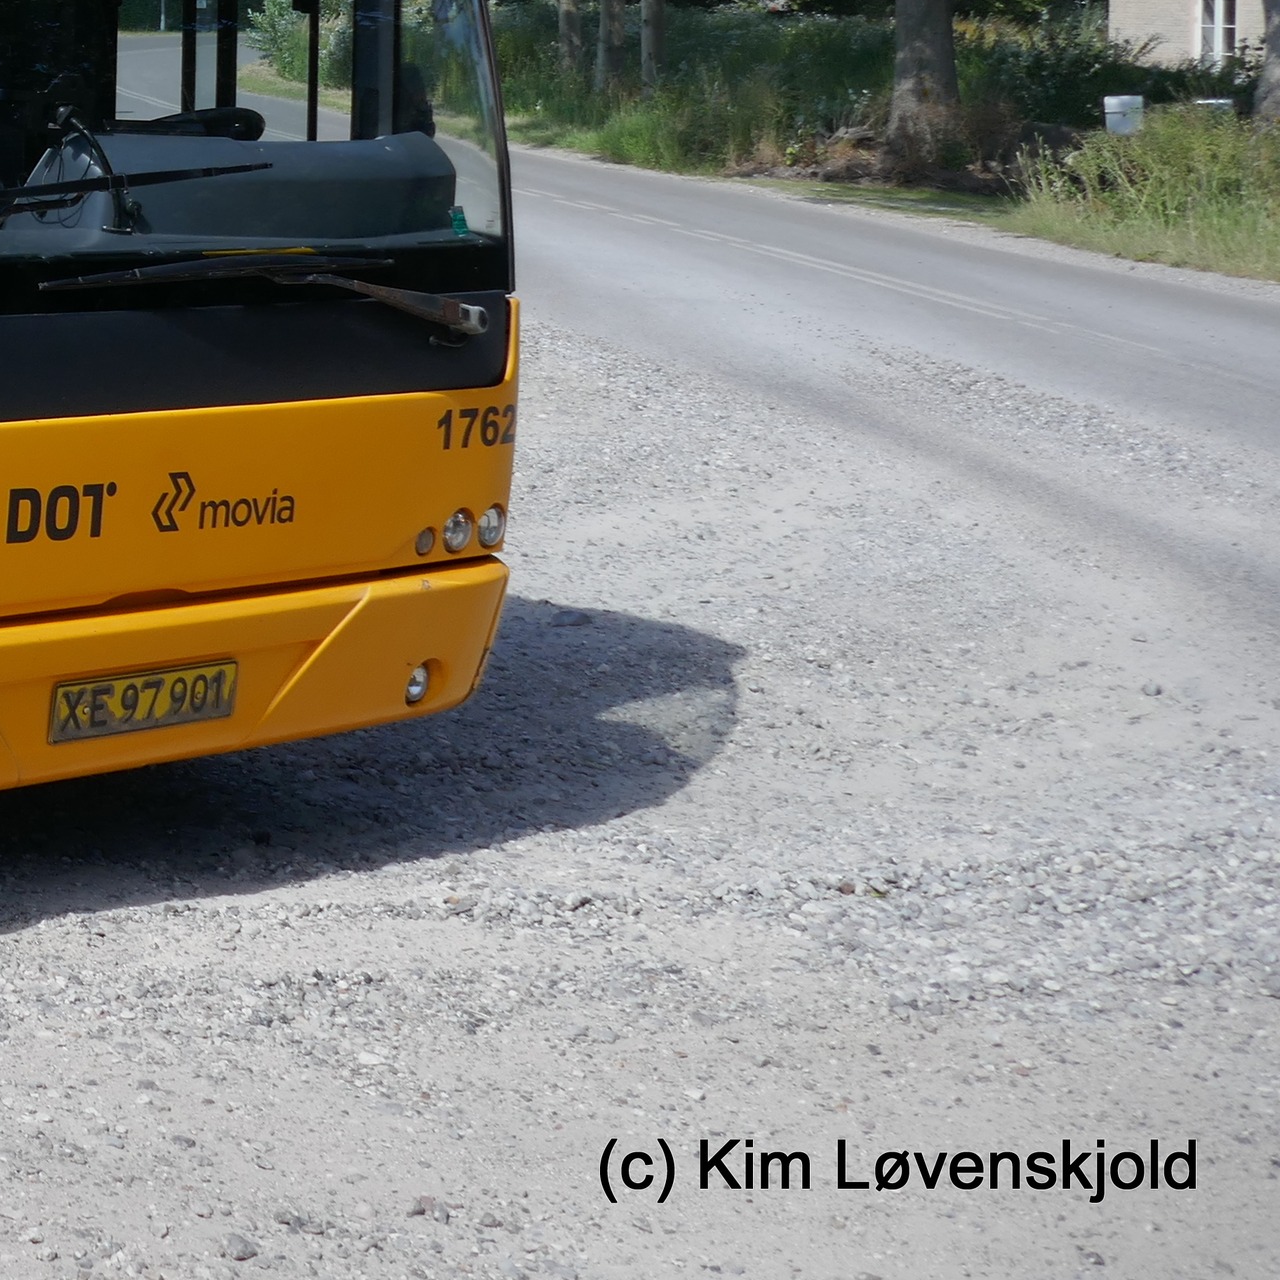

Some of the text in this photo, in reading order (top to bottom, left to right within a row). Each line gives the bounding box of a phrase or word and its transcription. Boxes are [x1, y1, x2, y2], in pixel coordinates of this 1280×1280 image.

[437, 403, 517, 450] 1762
[6, 480, 296, 545] DOT movia
